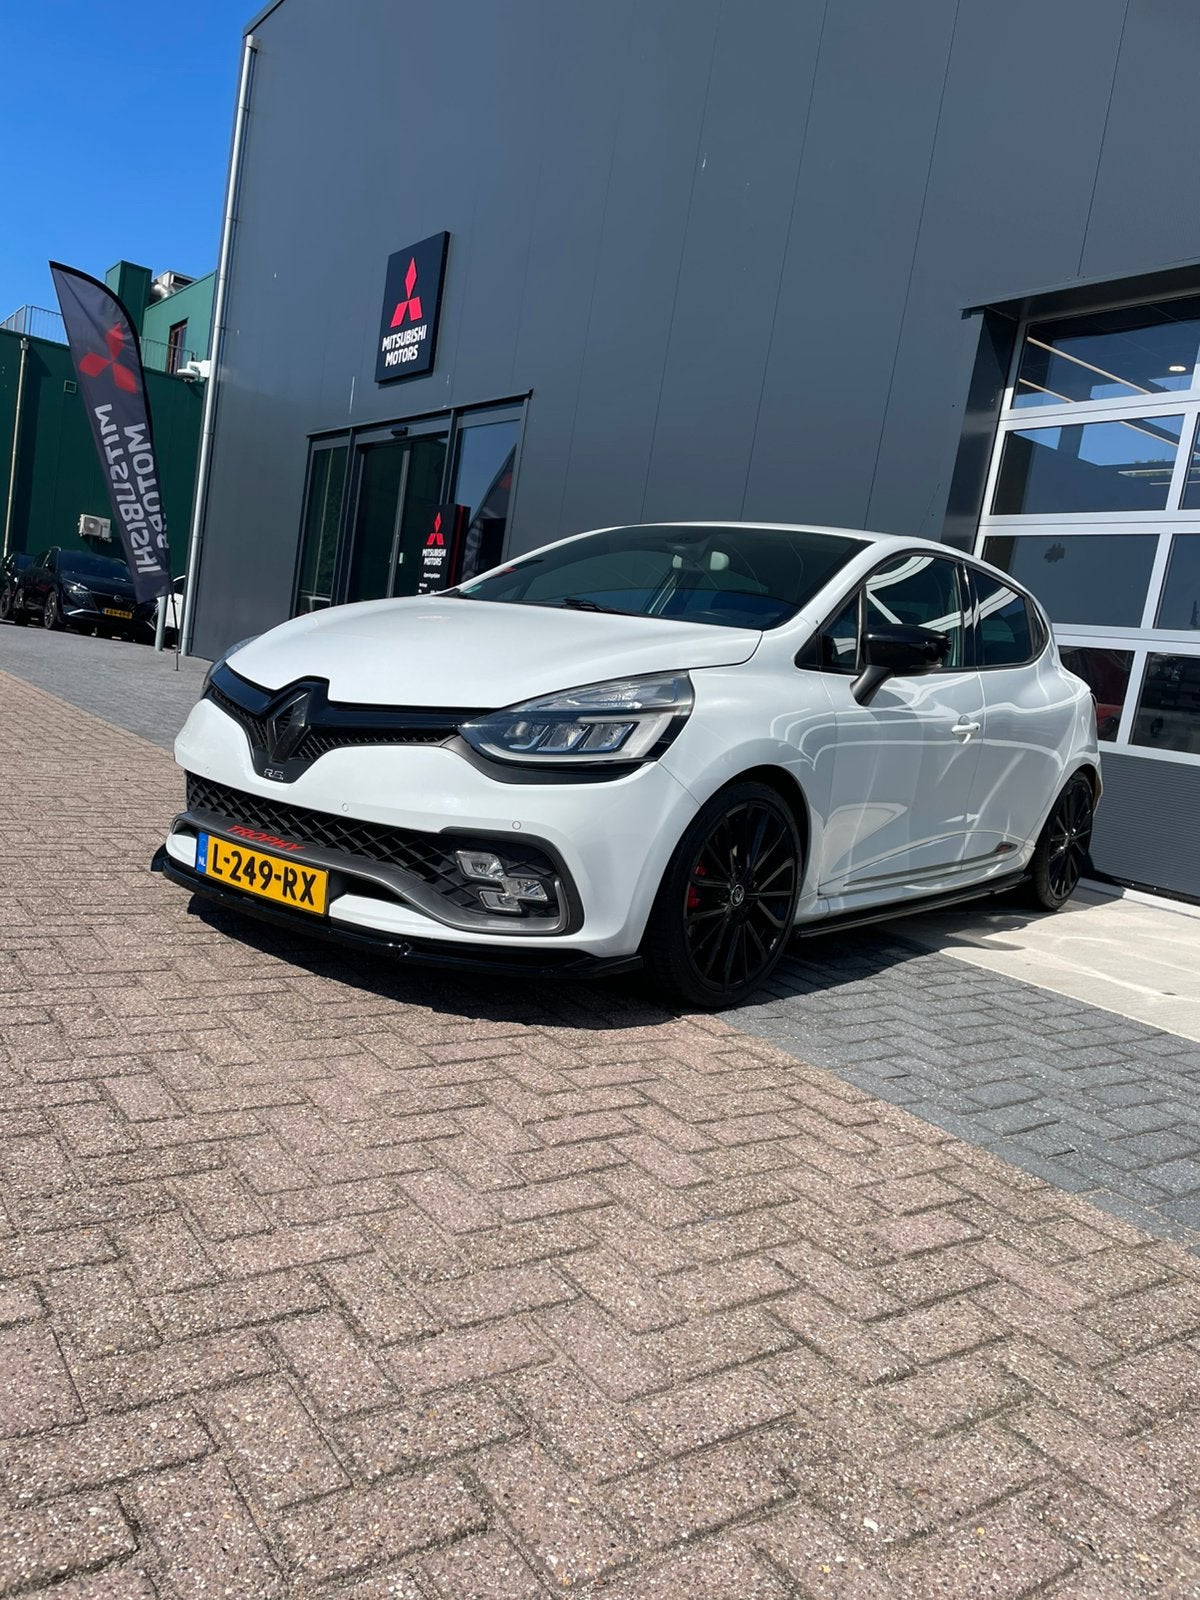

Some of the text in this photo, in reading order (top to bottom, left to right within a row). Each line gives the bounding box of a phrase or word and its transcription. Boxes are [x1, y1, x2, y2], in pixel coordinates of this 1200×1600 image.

[382, 324, 428, 352] MITSUBISHI
[385, 345, 419, 367] MOTORS
[422, 548, 447, 557] MITSUBISHI
[423, 557, 442, 566] MOTORS
[226, 824, 305, 852] TROPHY
[197, 856, 206, 867] NL
[211, 843, 317, 906] L-249-RX
